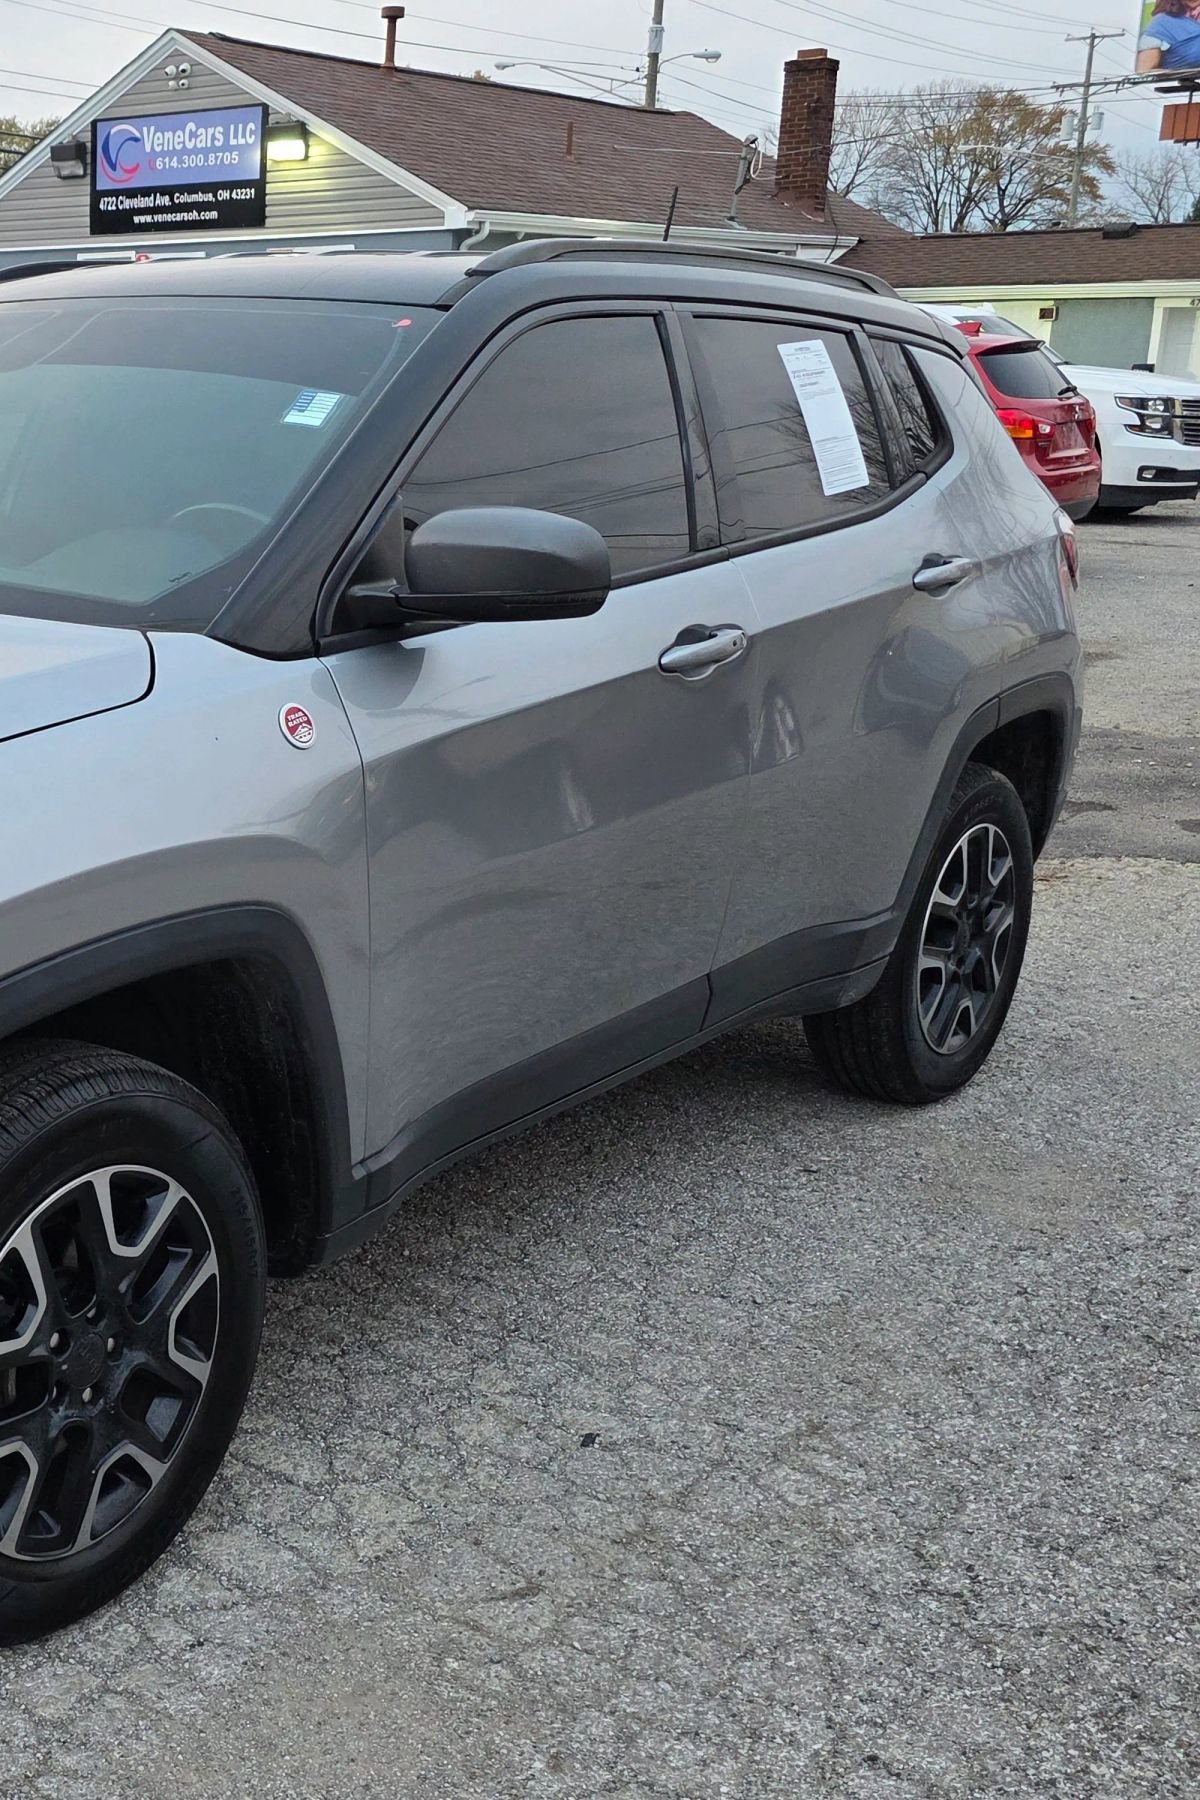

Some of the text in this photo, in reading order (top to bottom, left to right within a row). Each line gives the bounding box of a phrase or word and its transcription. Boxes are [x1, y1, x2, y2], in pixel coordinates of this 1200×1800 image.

[142, 122, 256, 152] VeneCars LLC
[155, 151, 239, 170] 614.300.8705
[99, 187, 255, 211] 4722 Cleveland Ave. Columbus, OH 43231
[133, 209, 218, 224] www.venecarsoh.com
